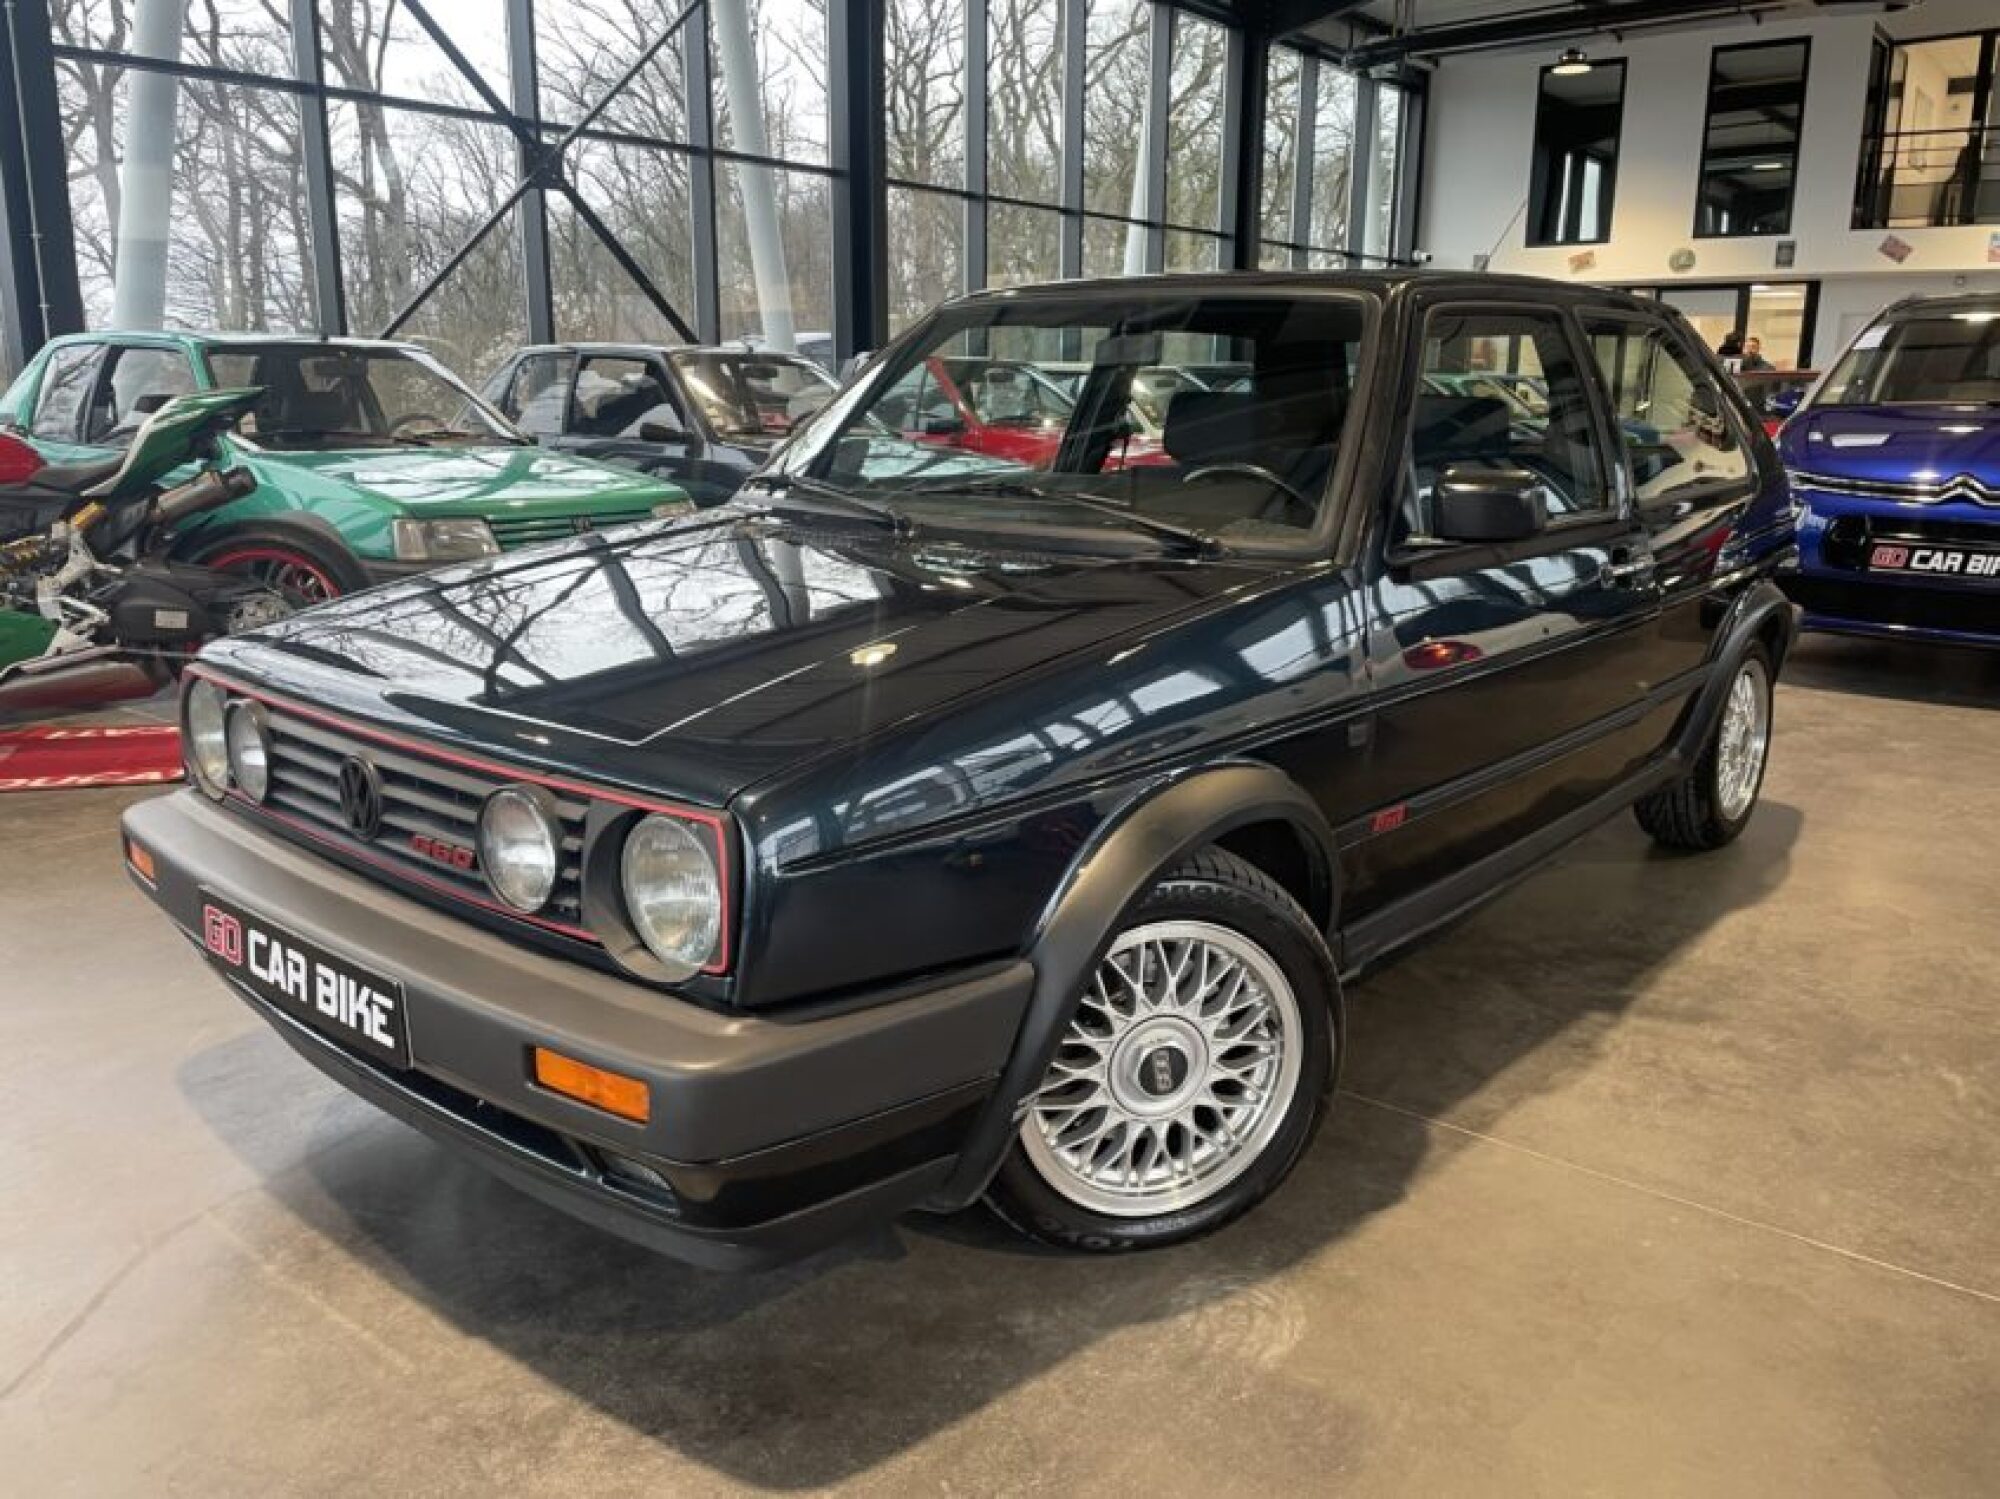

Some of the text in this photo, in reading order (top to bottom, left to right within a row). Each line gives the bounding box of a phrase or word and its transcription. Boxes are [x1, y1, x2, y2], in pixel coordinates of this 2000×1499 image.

[1910, 550, 1963, 572] CAR
[248, 929, 308, 1002] CAR
[315, 963, 395, 1048] BIKE
